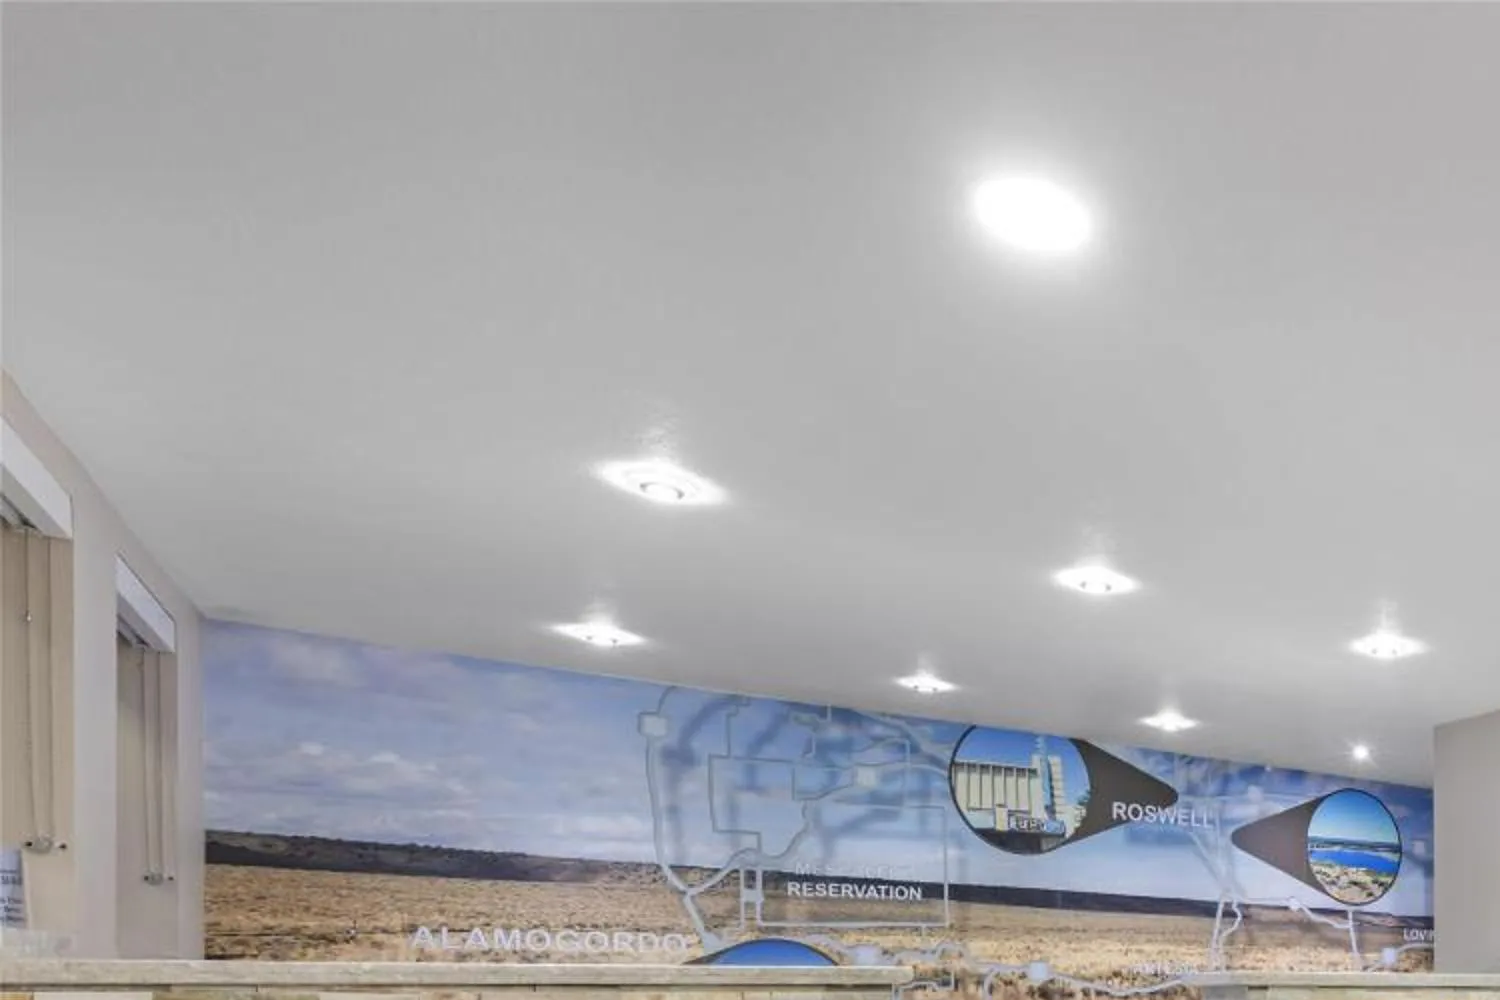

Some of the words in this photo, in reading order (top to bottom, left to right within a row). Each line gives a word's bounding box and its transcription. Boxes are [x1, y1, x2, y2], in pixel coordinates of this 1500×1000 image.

[1112, 801, 1213, 828] ROSWELL
[787, 881, 922, 900] RESERVATION
[411, 926, 687, 952] ALAMOGORDO
